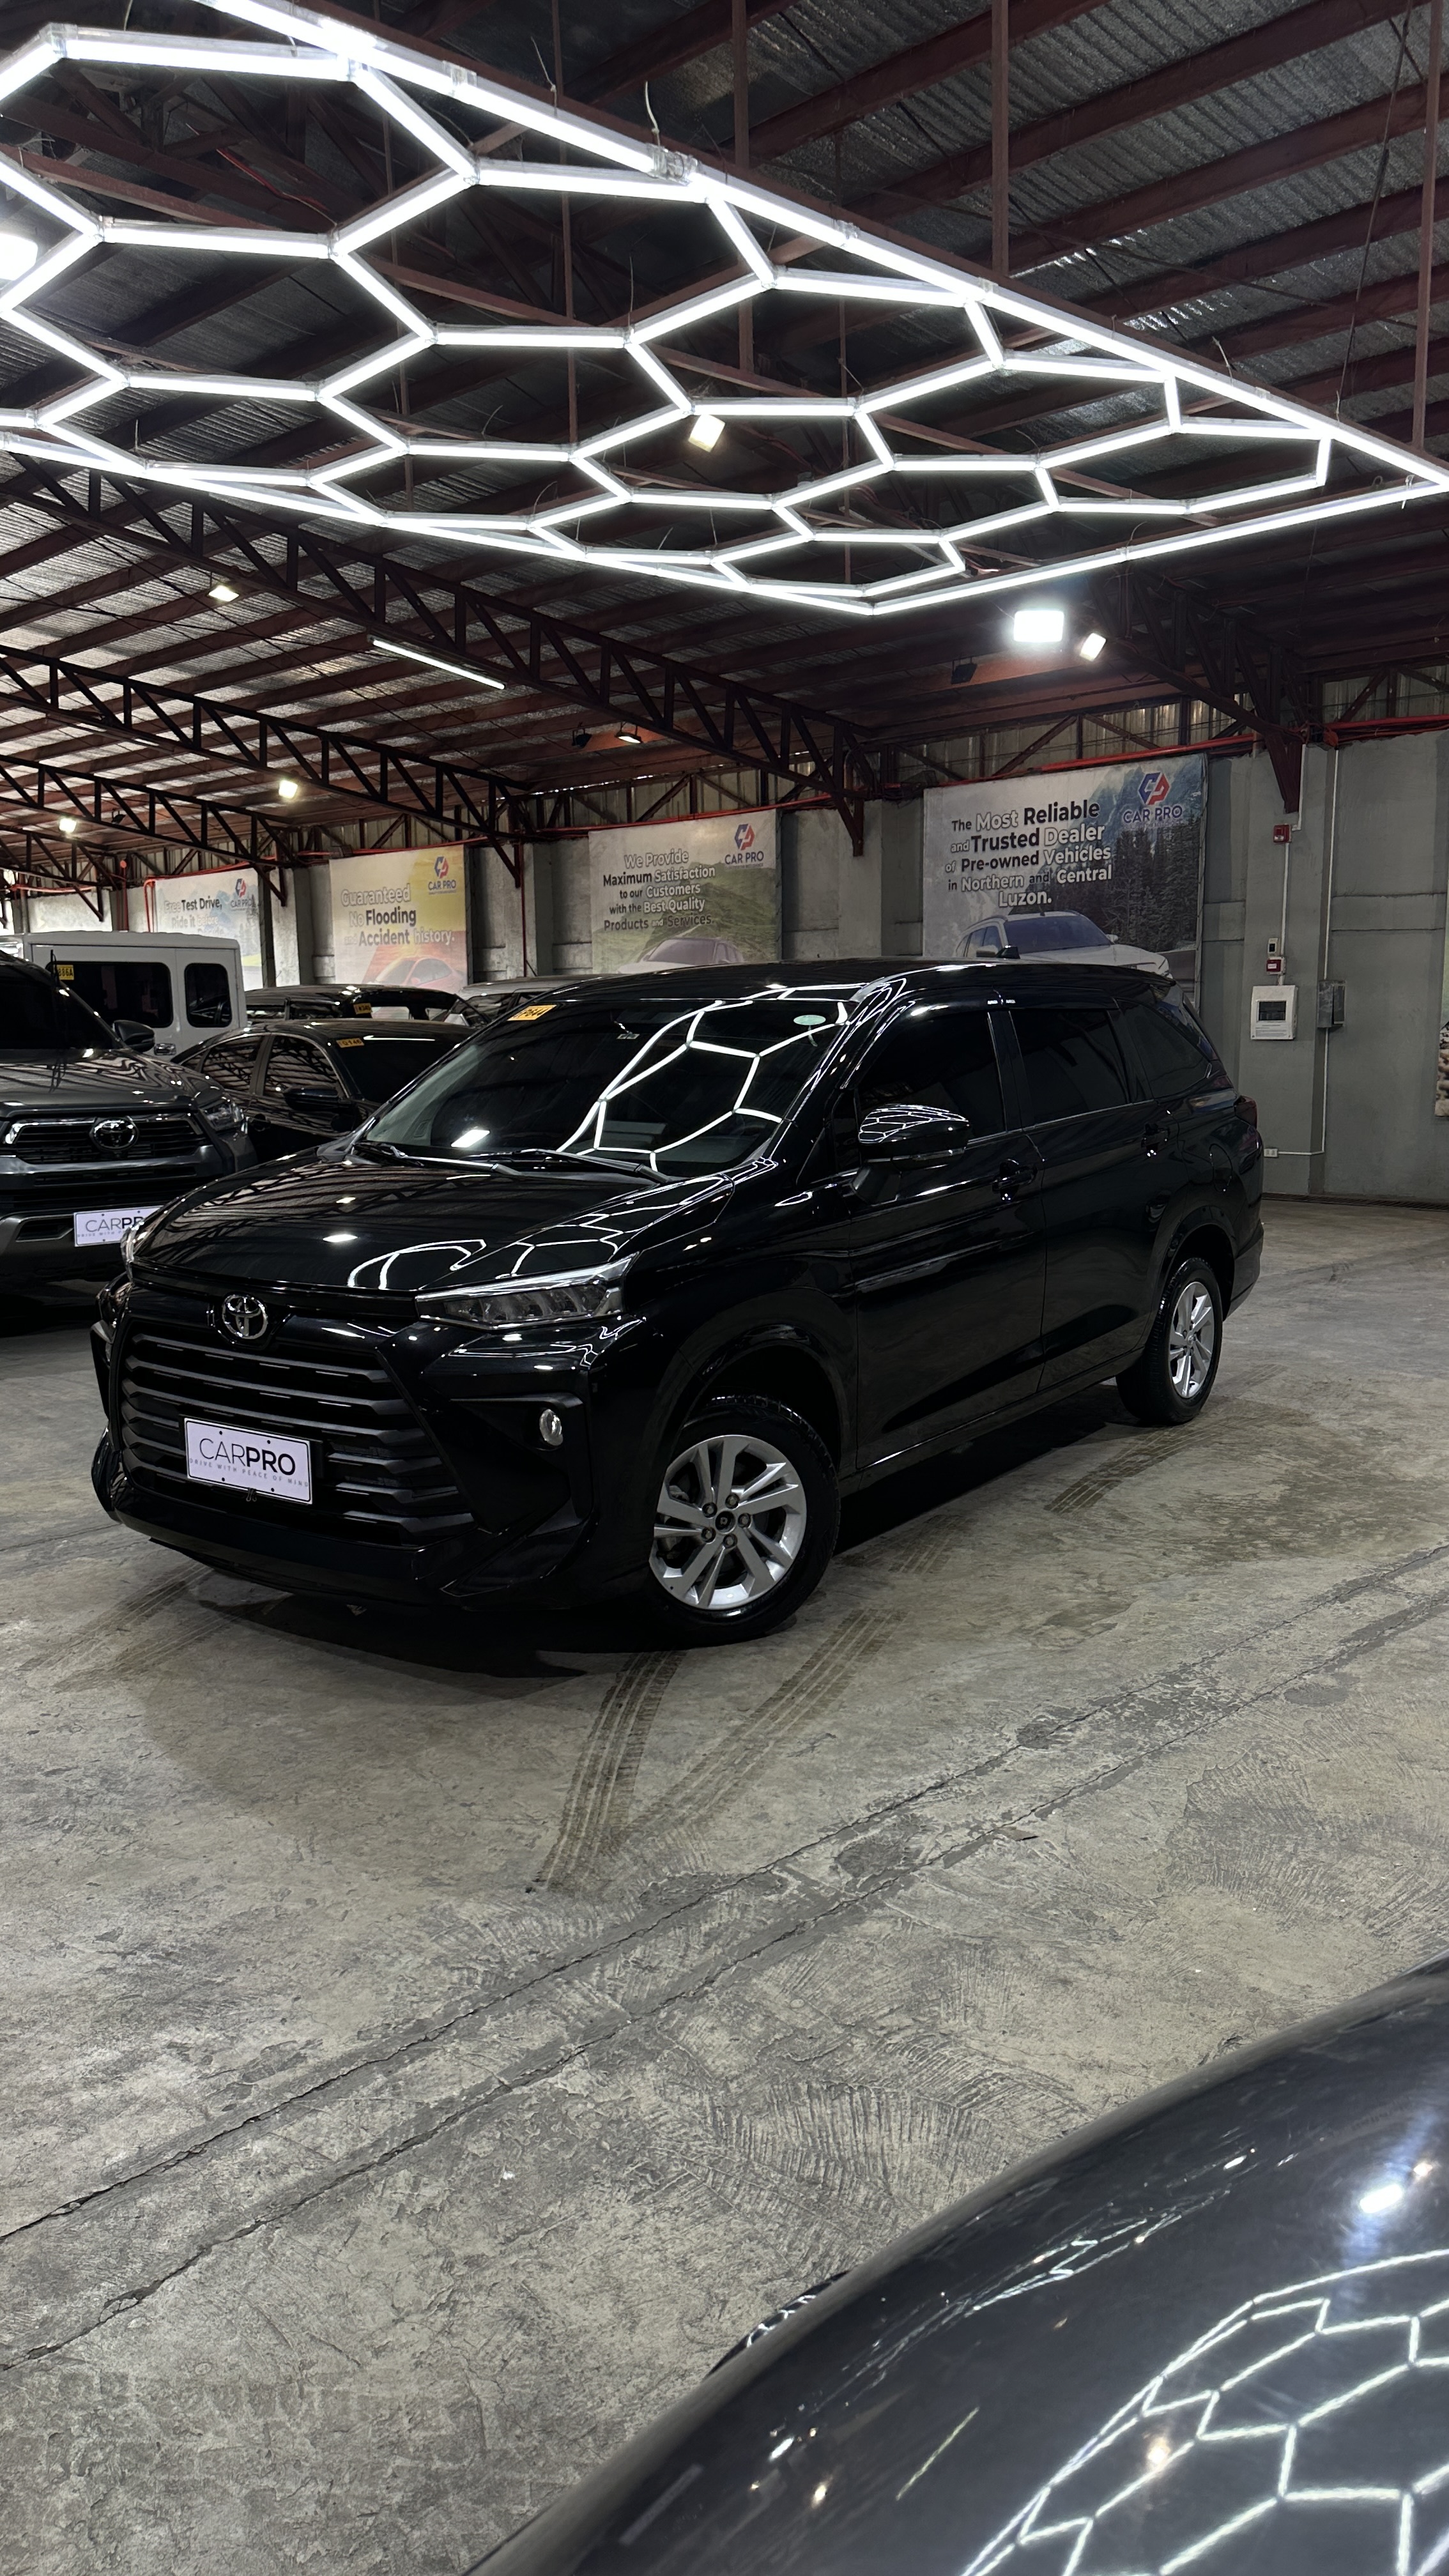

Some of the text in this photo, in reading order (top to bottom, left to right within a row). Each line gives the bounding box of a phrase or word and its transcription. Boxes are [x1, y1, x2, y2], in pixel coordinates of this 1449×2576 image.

[952, 799, 1100, 831] The Most Reliable
[1123, 805, 1183, 824] CAR PRO
[951, 839, 970, 853] and
[971, 827, 1039, 852] Trusted
[1044, 823, 1105, 847] Dealer
[624, 848, 689, 870] We Provide
[724, 850, 764, 865] CAR PRO
[945, 845, 1111, 873] of Pre-owned Vehicles
[428, 879, 456, 891] CAR PRO
[603, 865, 716, 887] Maximum Satisfaction
[948, 864, 1112, 893] in Northern and Central
[341, 883, 411, 907] Guaranteed
[620, 884, 701, 899] to our Customers
[999, 890, 1052, 908] Luzon.
[181, 899, 198, 911] Test
[199, 896, 222, 910] Drive,
[610, 896, 705, 915] with the Best Quality
[171, 914, 188, 928] Ride
[190, 914, 195, 926] it
[349, 905, 417, 928] No Flooding
[604, 912, 714, 931] Products and Services.
[359, 928, 410, 946] Accident
[413, 926, 455, 946] history.
[199, 1438, 296, 1476] CARPRO
[190, 1458, 212, 1468] DRIVE
[242, 1469, 267, 1479] PEACE
[288, 1478, 308, 1487] MIND
